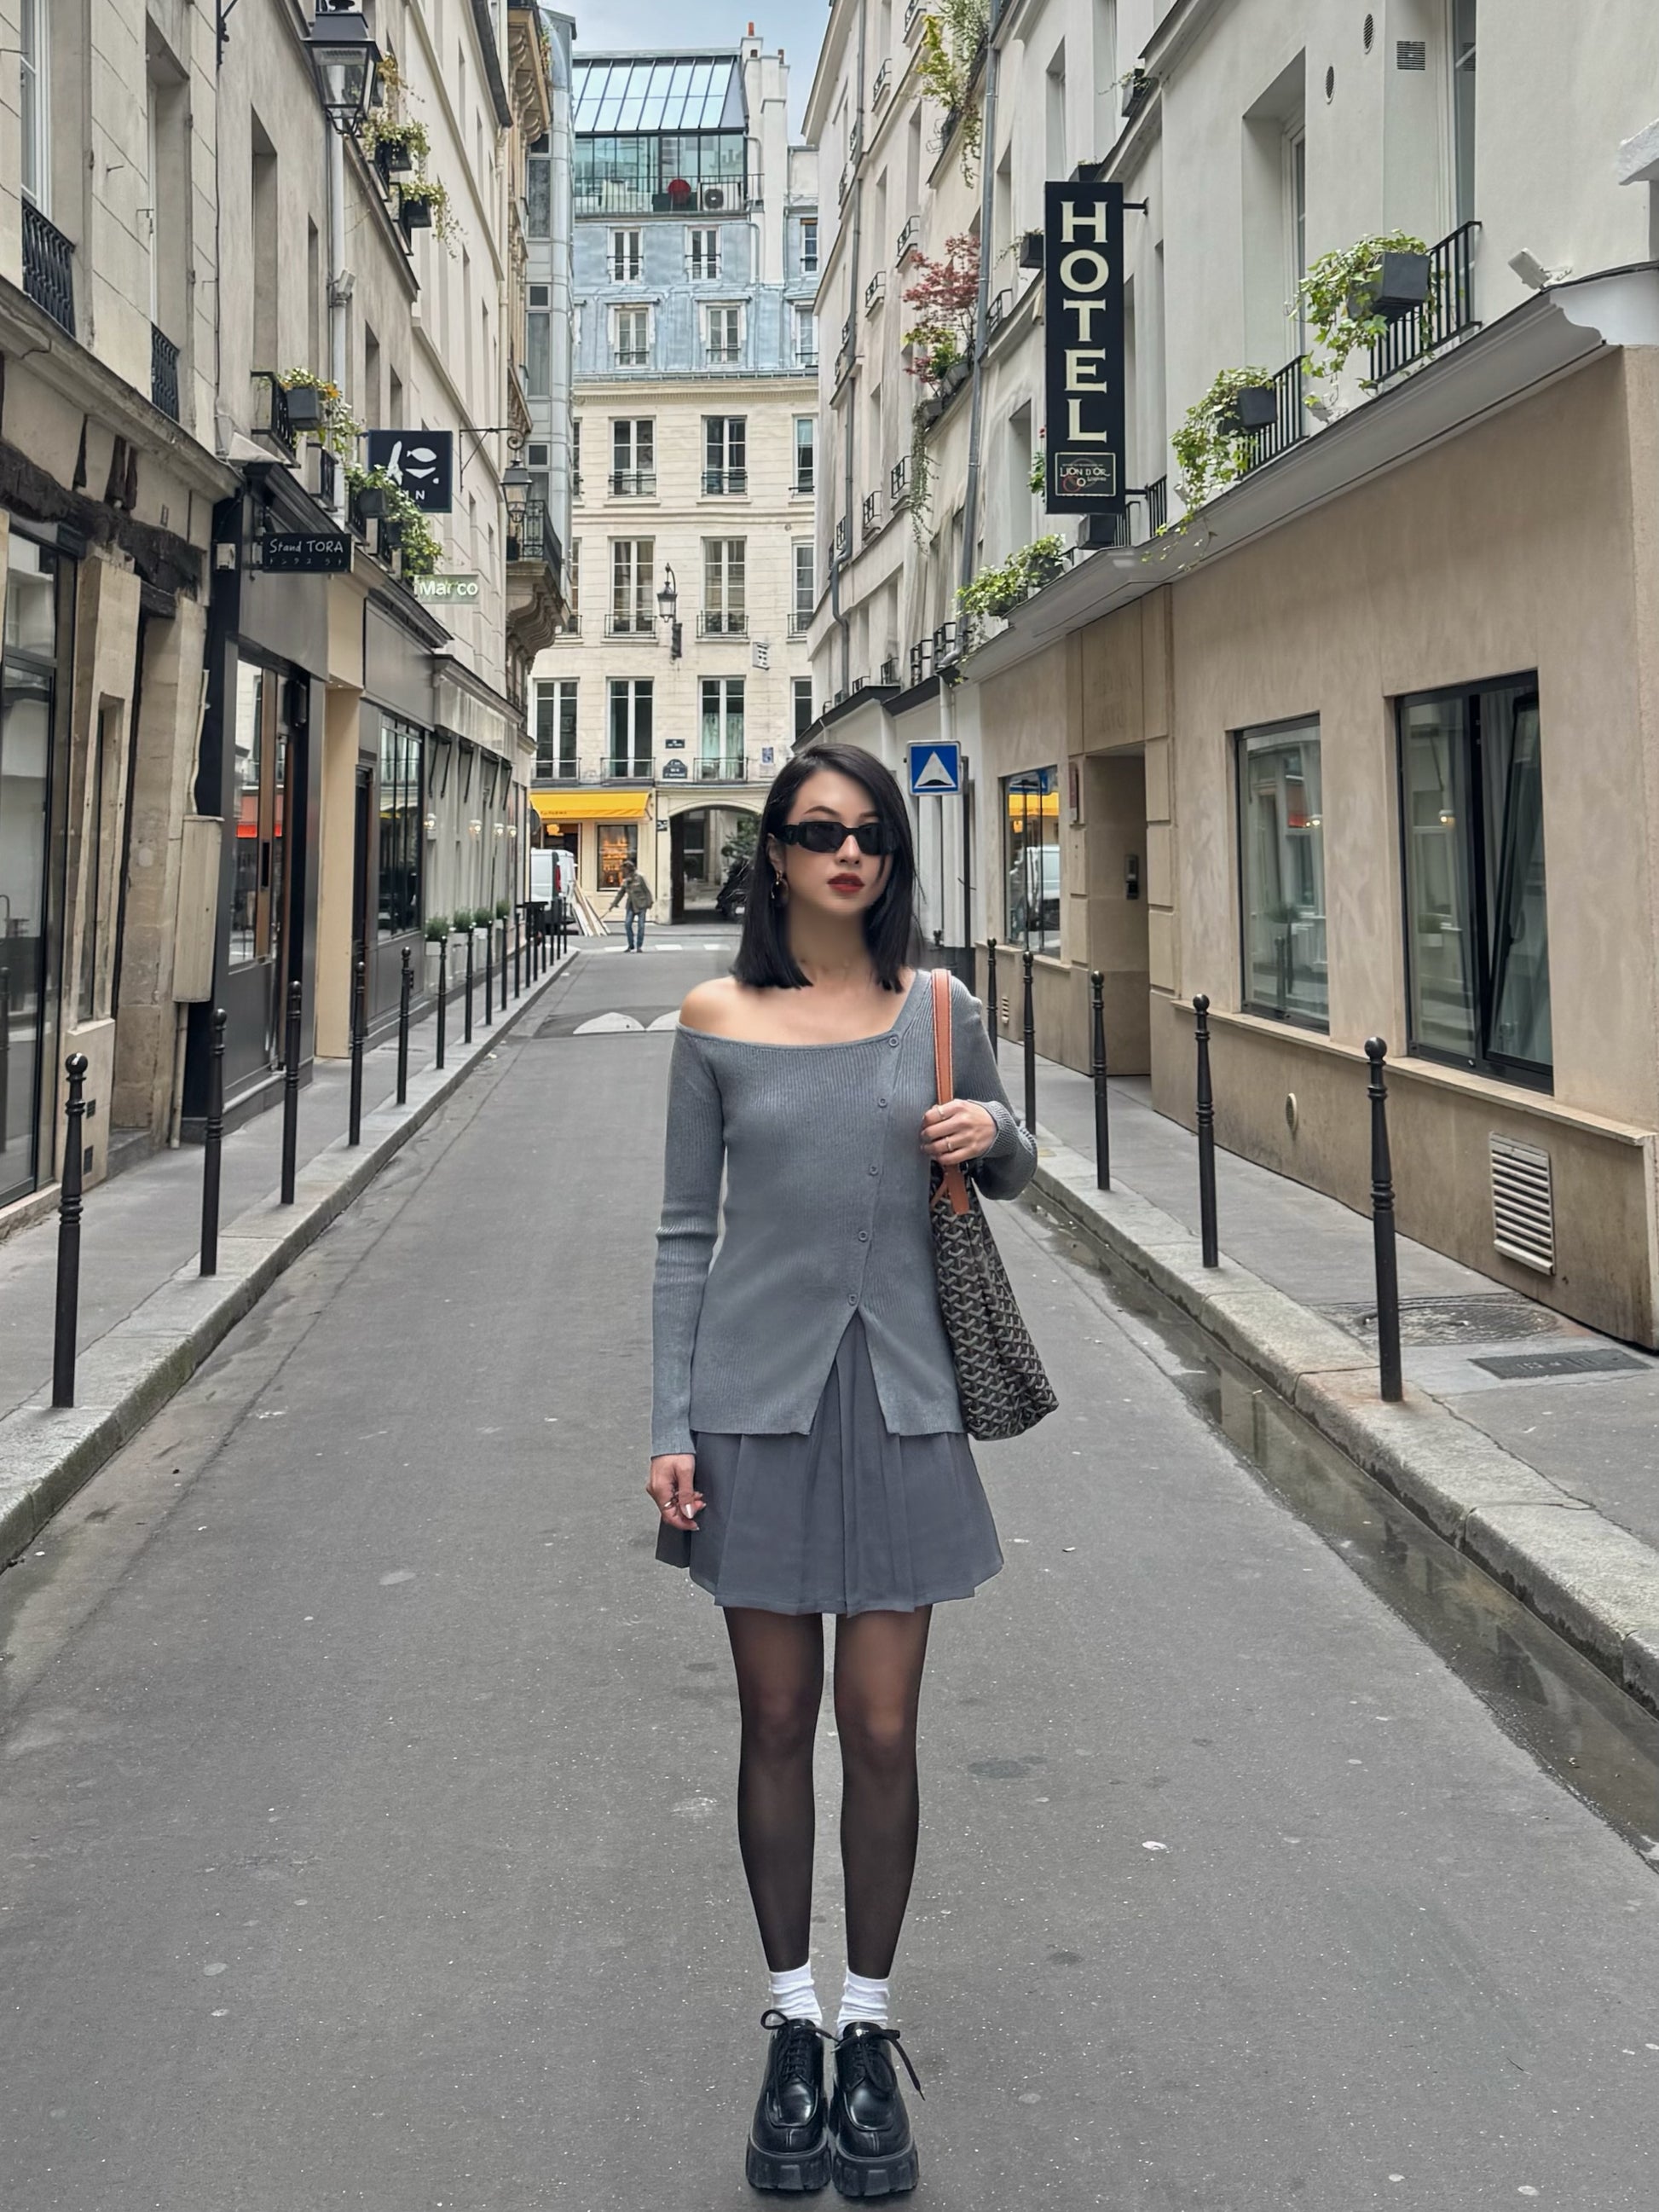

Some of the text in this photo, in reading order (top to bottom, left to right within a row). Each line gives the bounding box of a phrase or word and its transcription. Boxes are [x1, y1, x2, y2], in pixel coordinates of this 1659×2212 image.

[1060, 201, 1109, 443] HOTEL
[269, 539, 344, 553] Stand TORA
